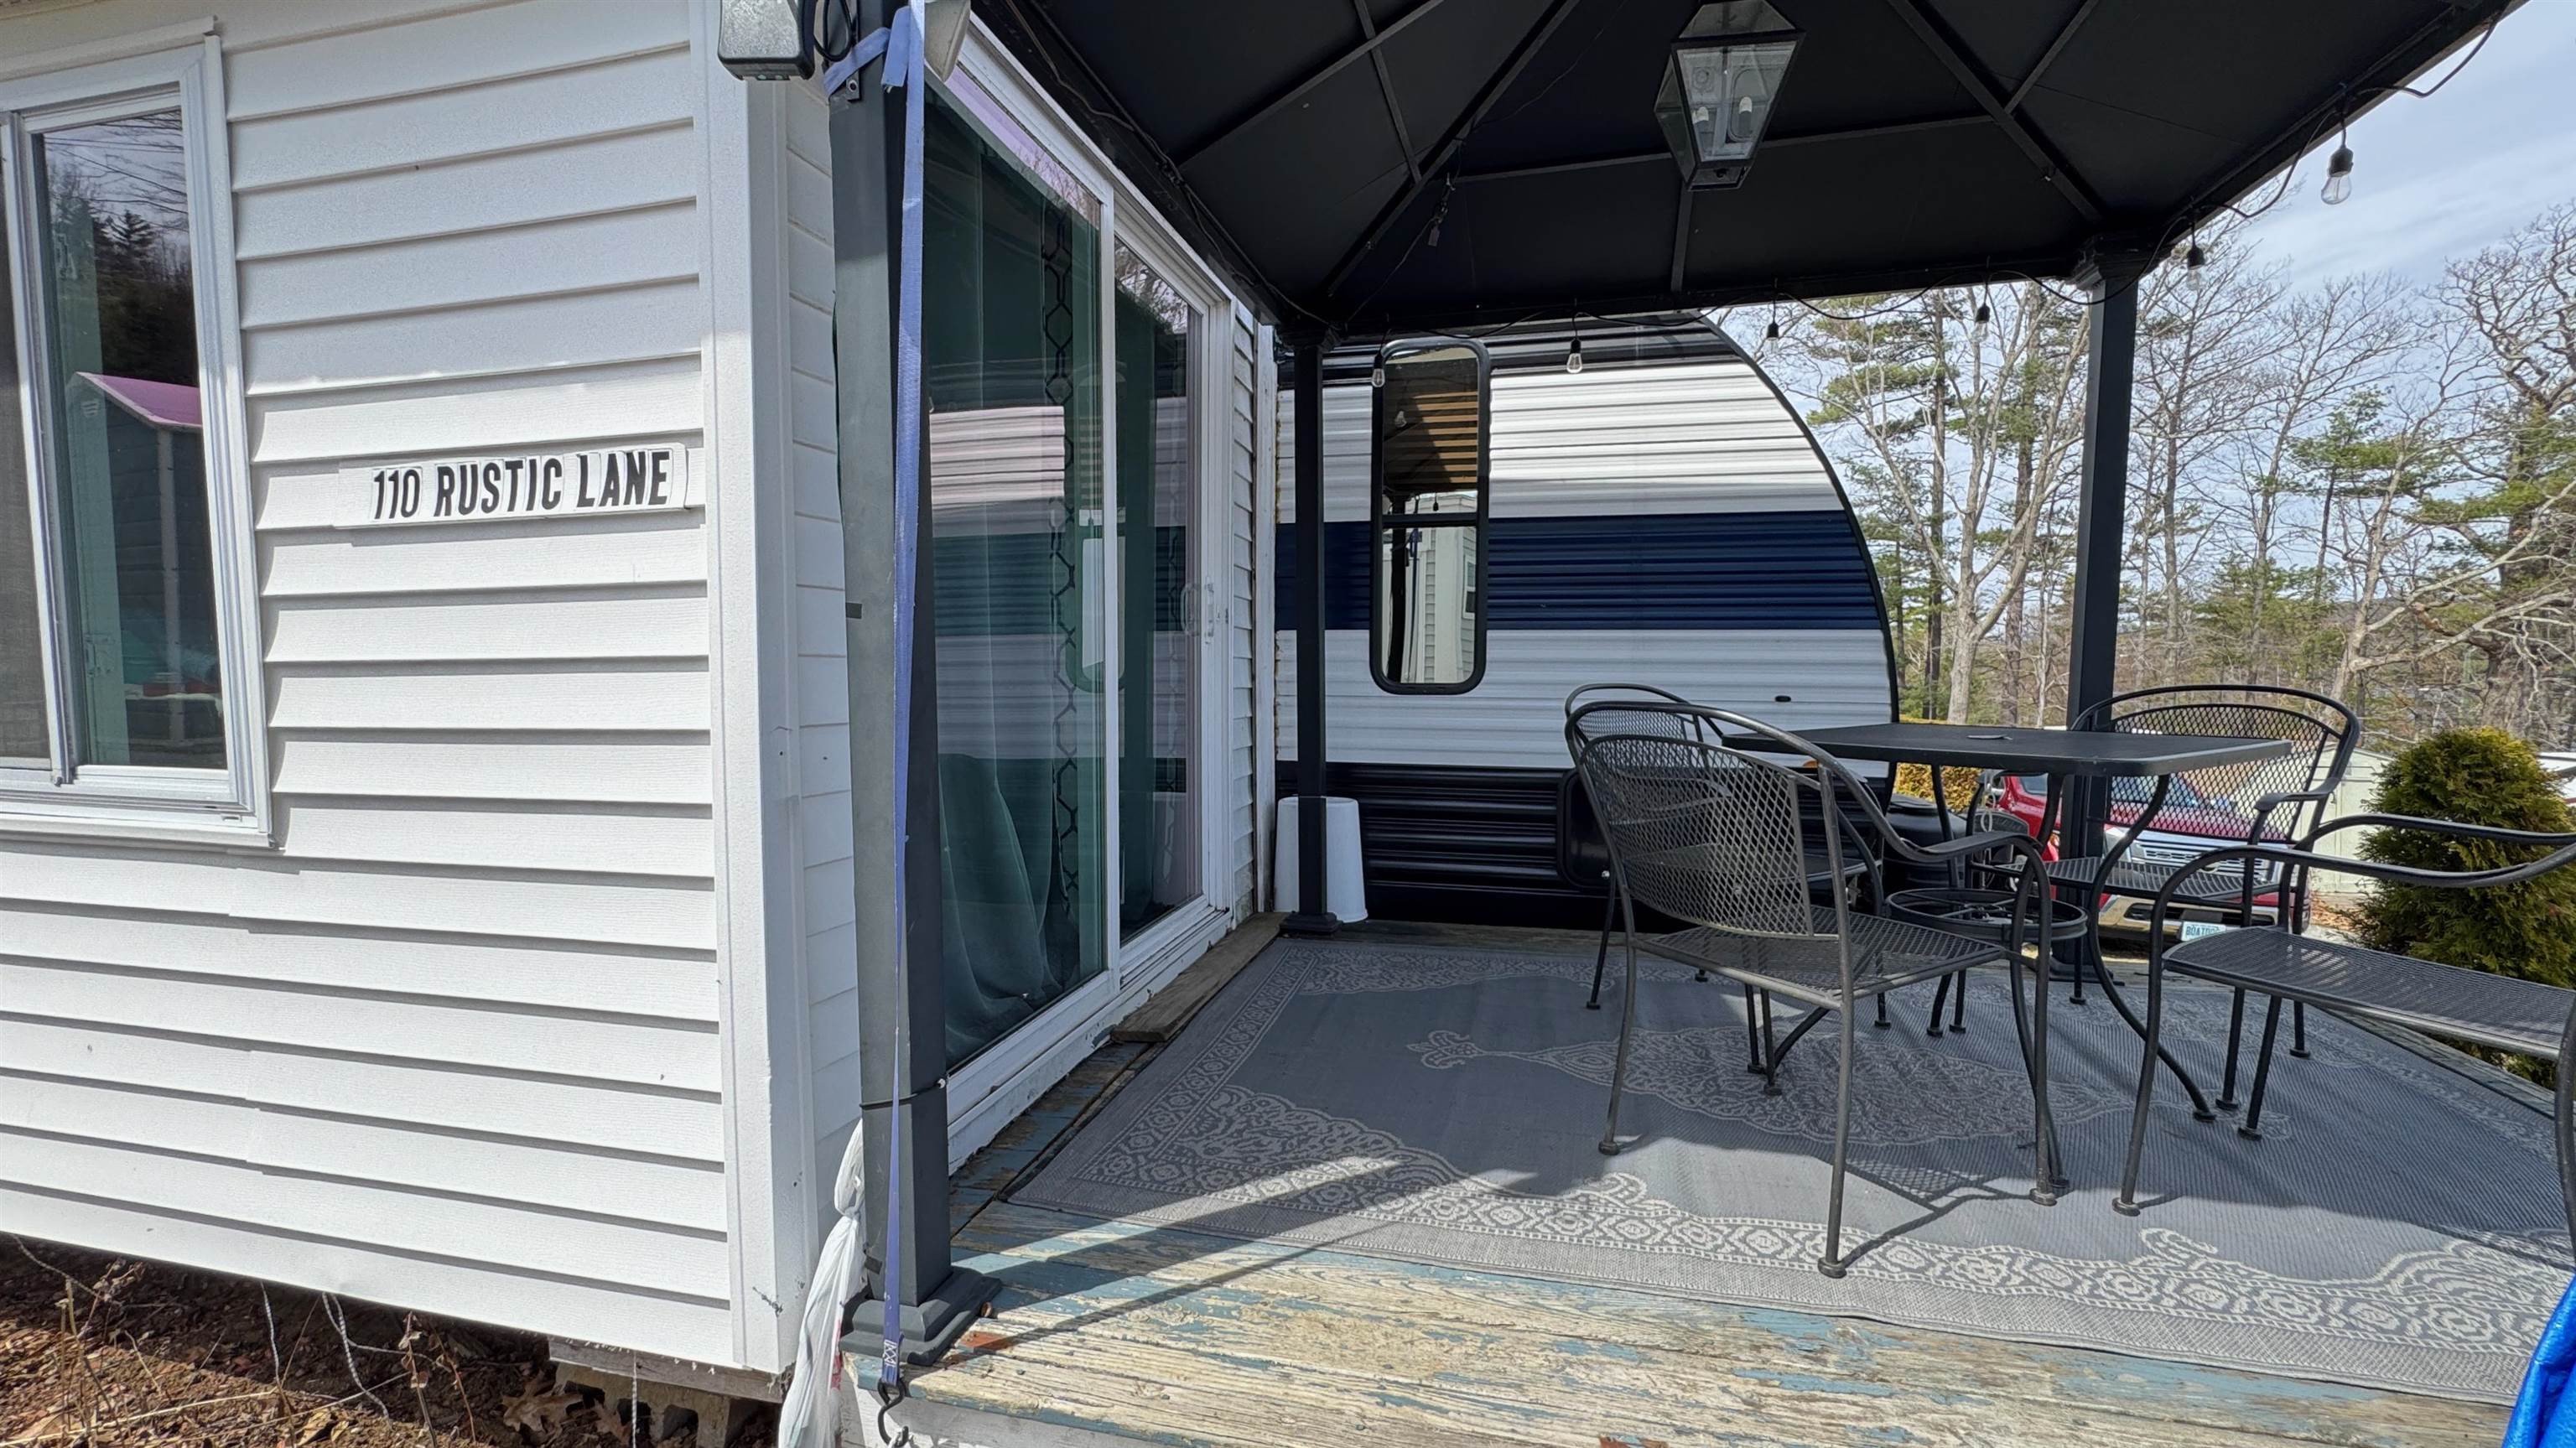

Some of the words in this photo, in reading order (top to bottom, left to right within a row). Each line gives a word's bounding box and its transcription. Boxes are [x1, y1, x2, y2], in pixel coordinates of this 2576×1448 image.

[373, 469, 421, 520] 110
[434, 459, 563, 517] RUSTIC
[576, 449, 670, 508] LANE
